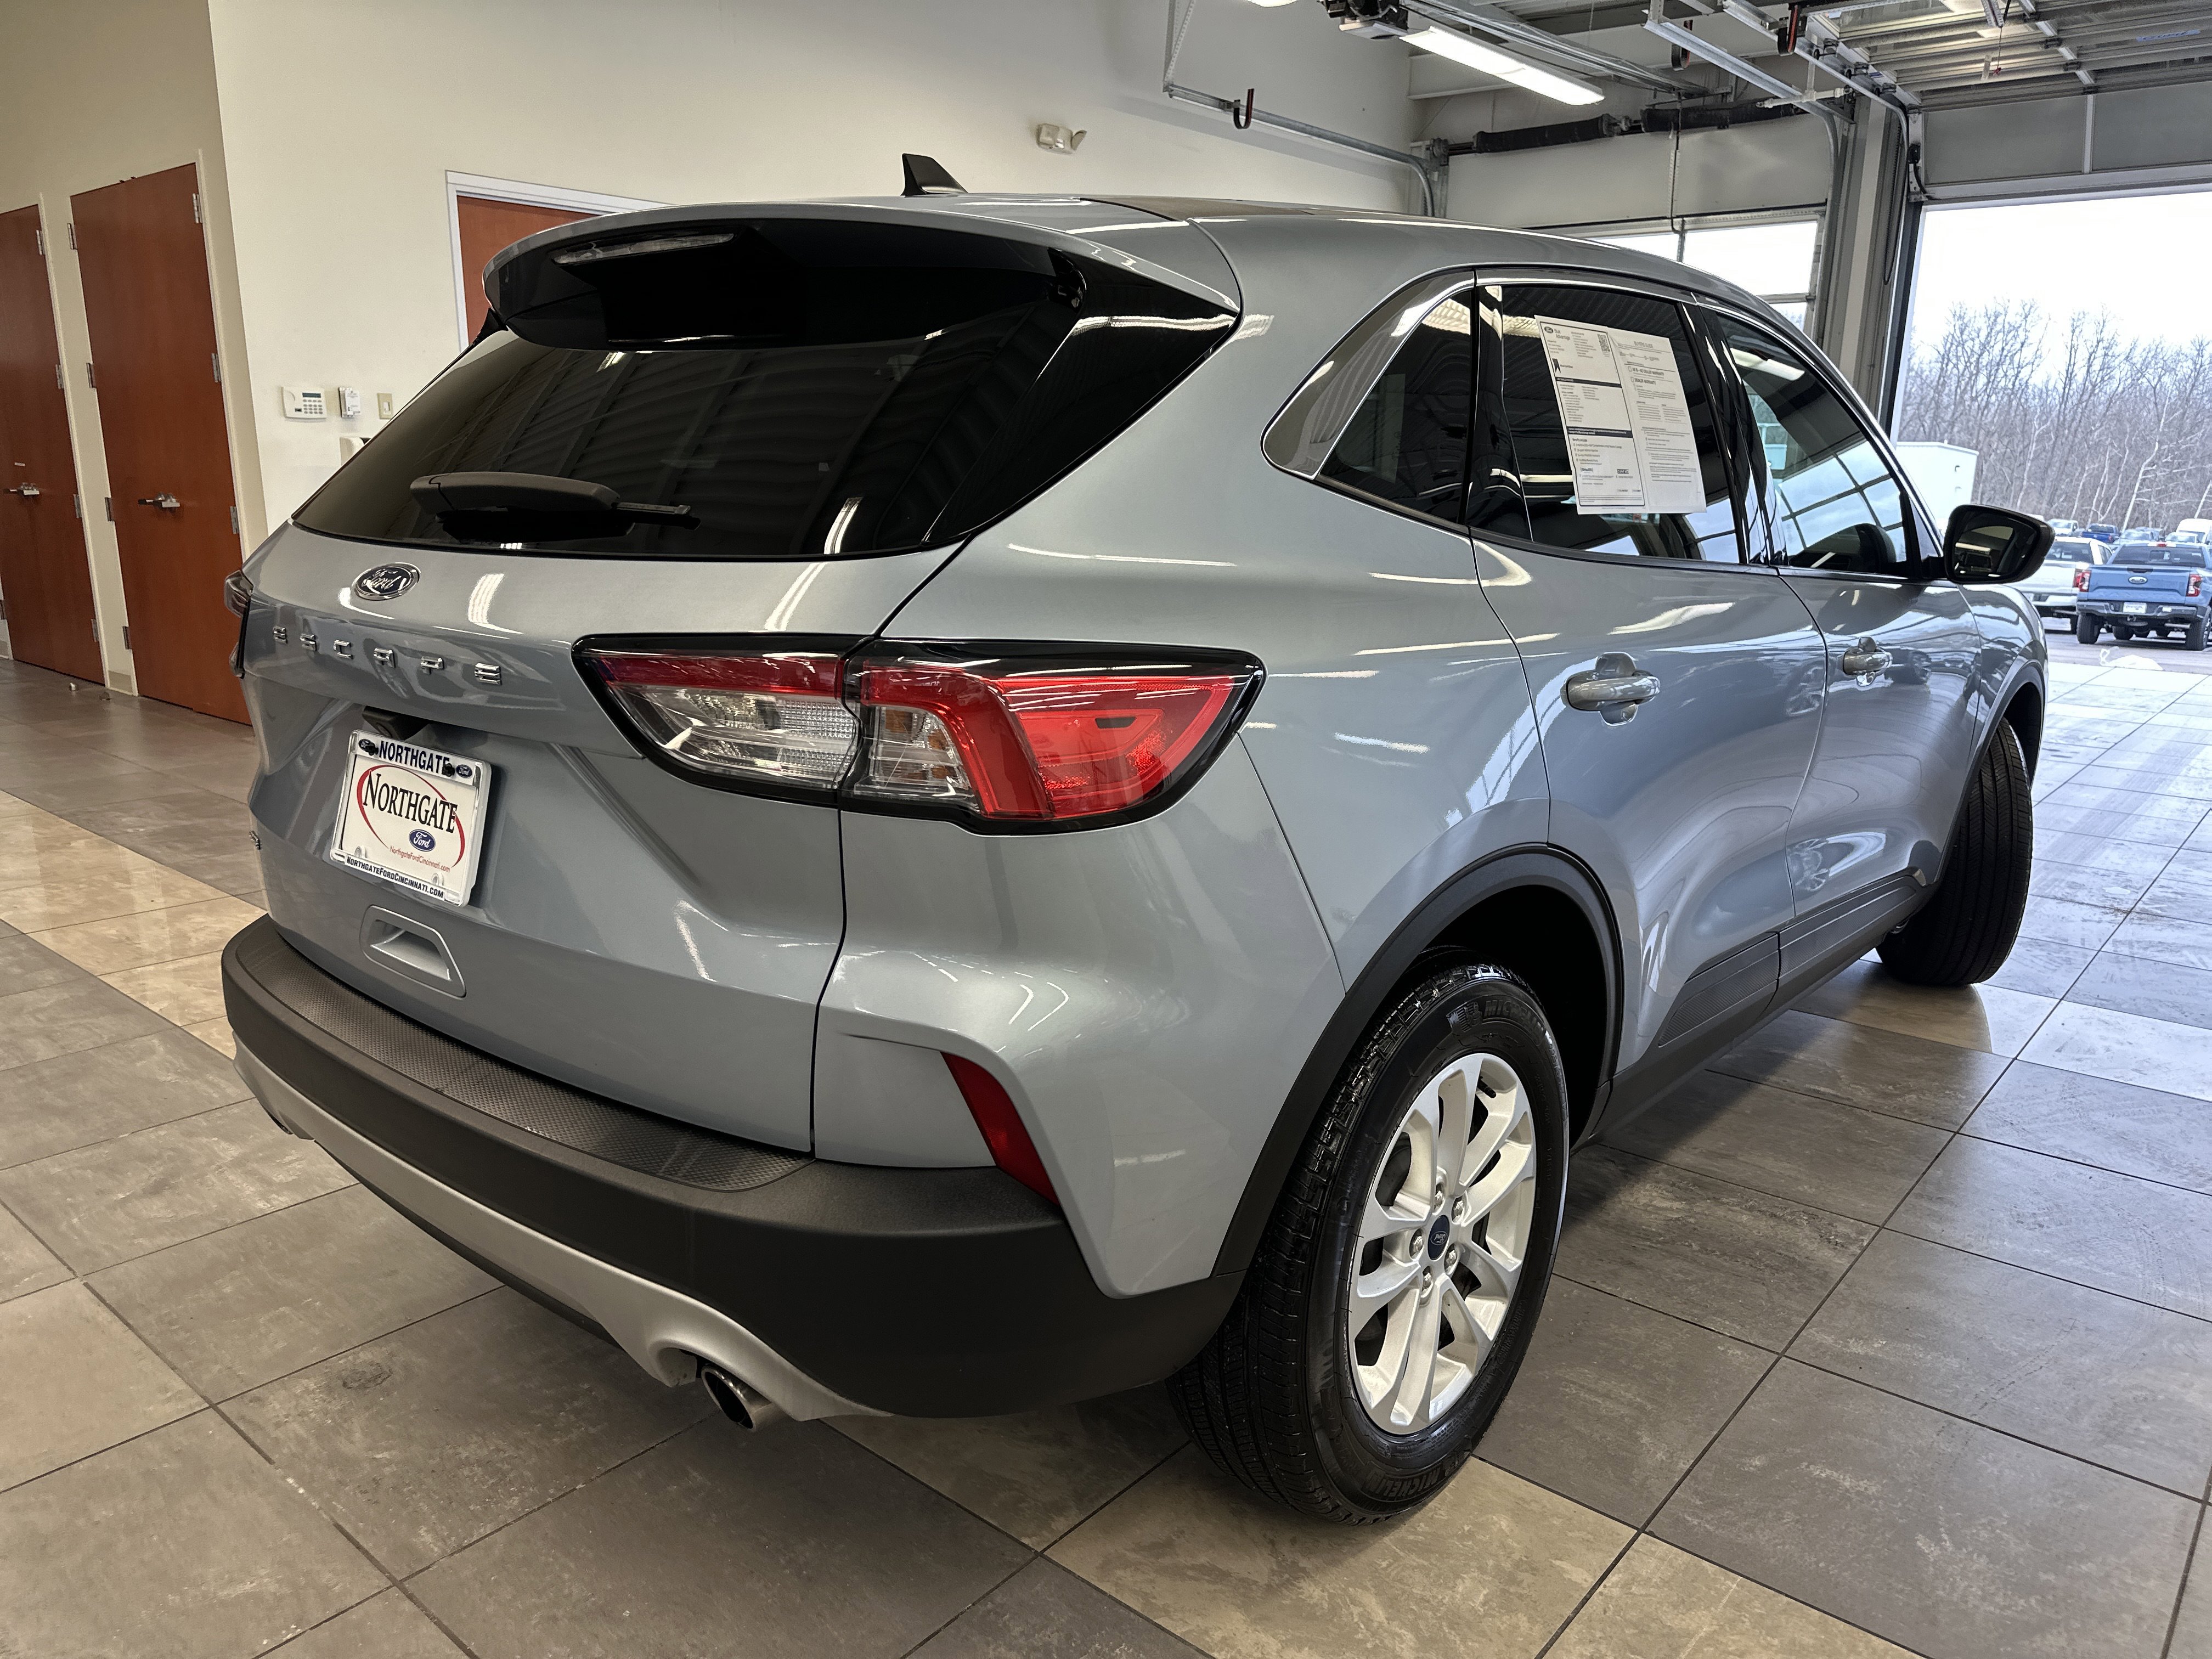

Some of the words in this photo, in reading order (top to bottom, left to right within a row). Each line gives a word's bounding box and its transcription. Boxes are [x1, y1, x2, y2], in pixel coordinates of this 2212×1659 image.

[273, 625, 501, 685] ESCAPE
[413, 831, 432, 849] Ford
[390, 845, 450, 873] NorthgateFordCincinnati.com
[1483, 999, 1544, 1037] MICHELIN
